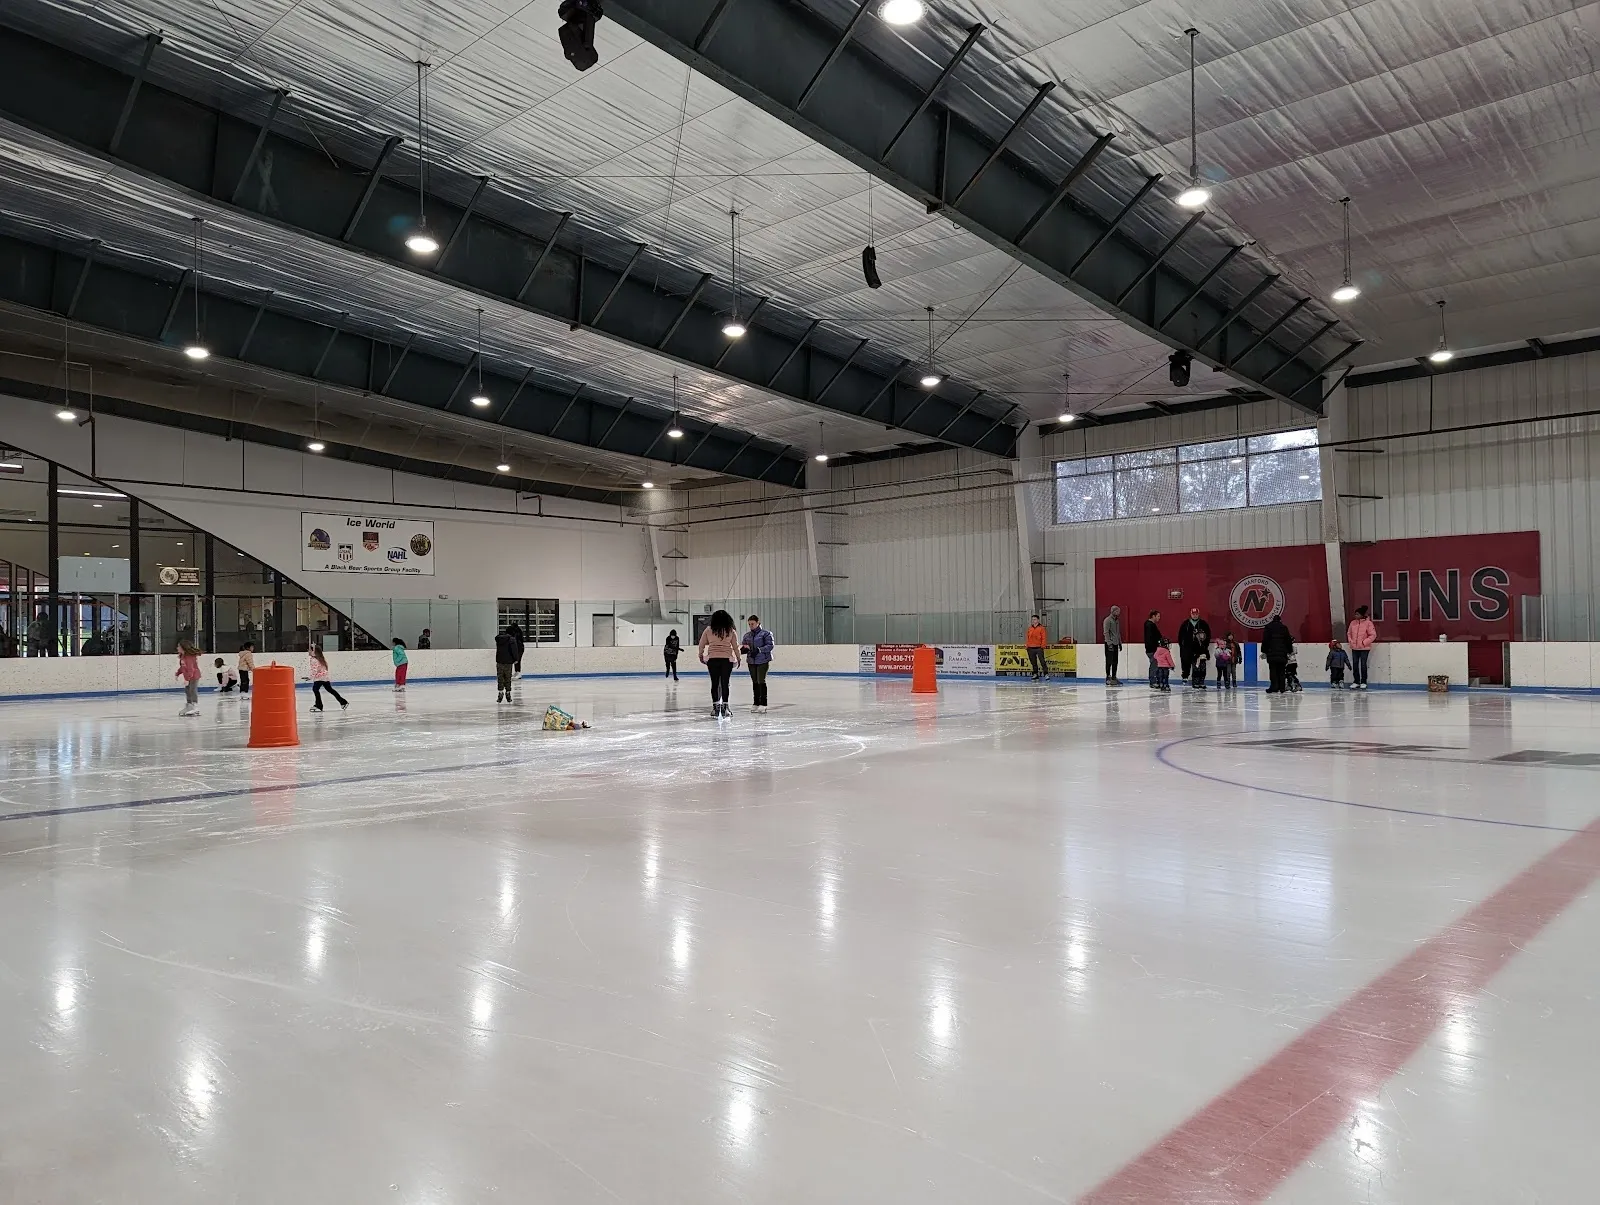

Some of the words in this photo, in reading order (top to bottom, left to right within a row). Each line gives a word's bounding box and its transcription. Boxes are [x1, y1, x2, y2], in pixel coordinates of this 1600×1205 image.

[346, 517, 362, 527] Ice
[365, 518, 396, 529] World
[387, 550, 408, 560] NAHL
[1244, 578, 1269, 586] HARFORD
[1370, 565, 1510, 622] HNS
[1242, 616, 1259, 626] STARS
